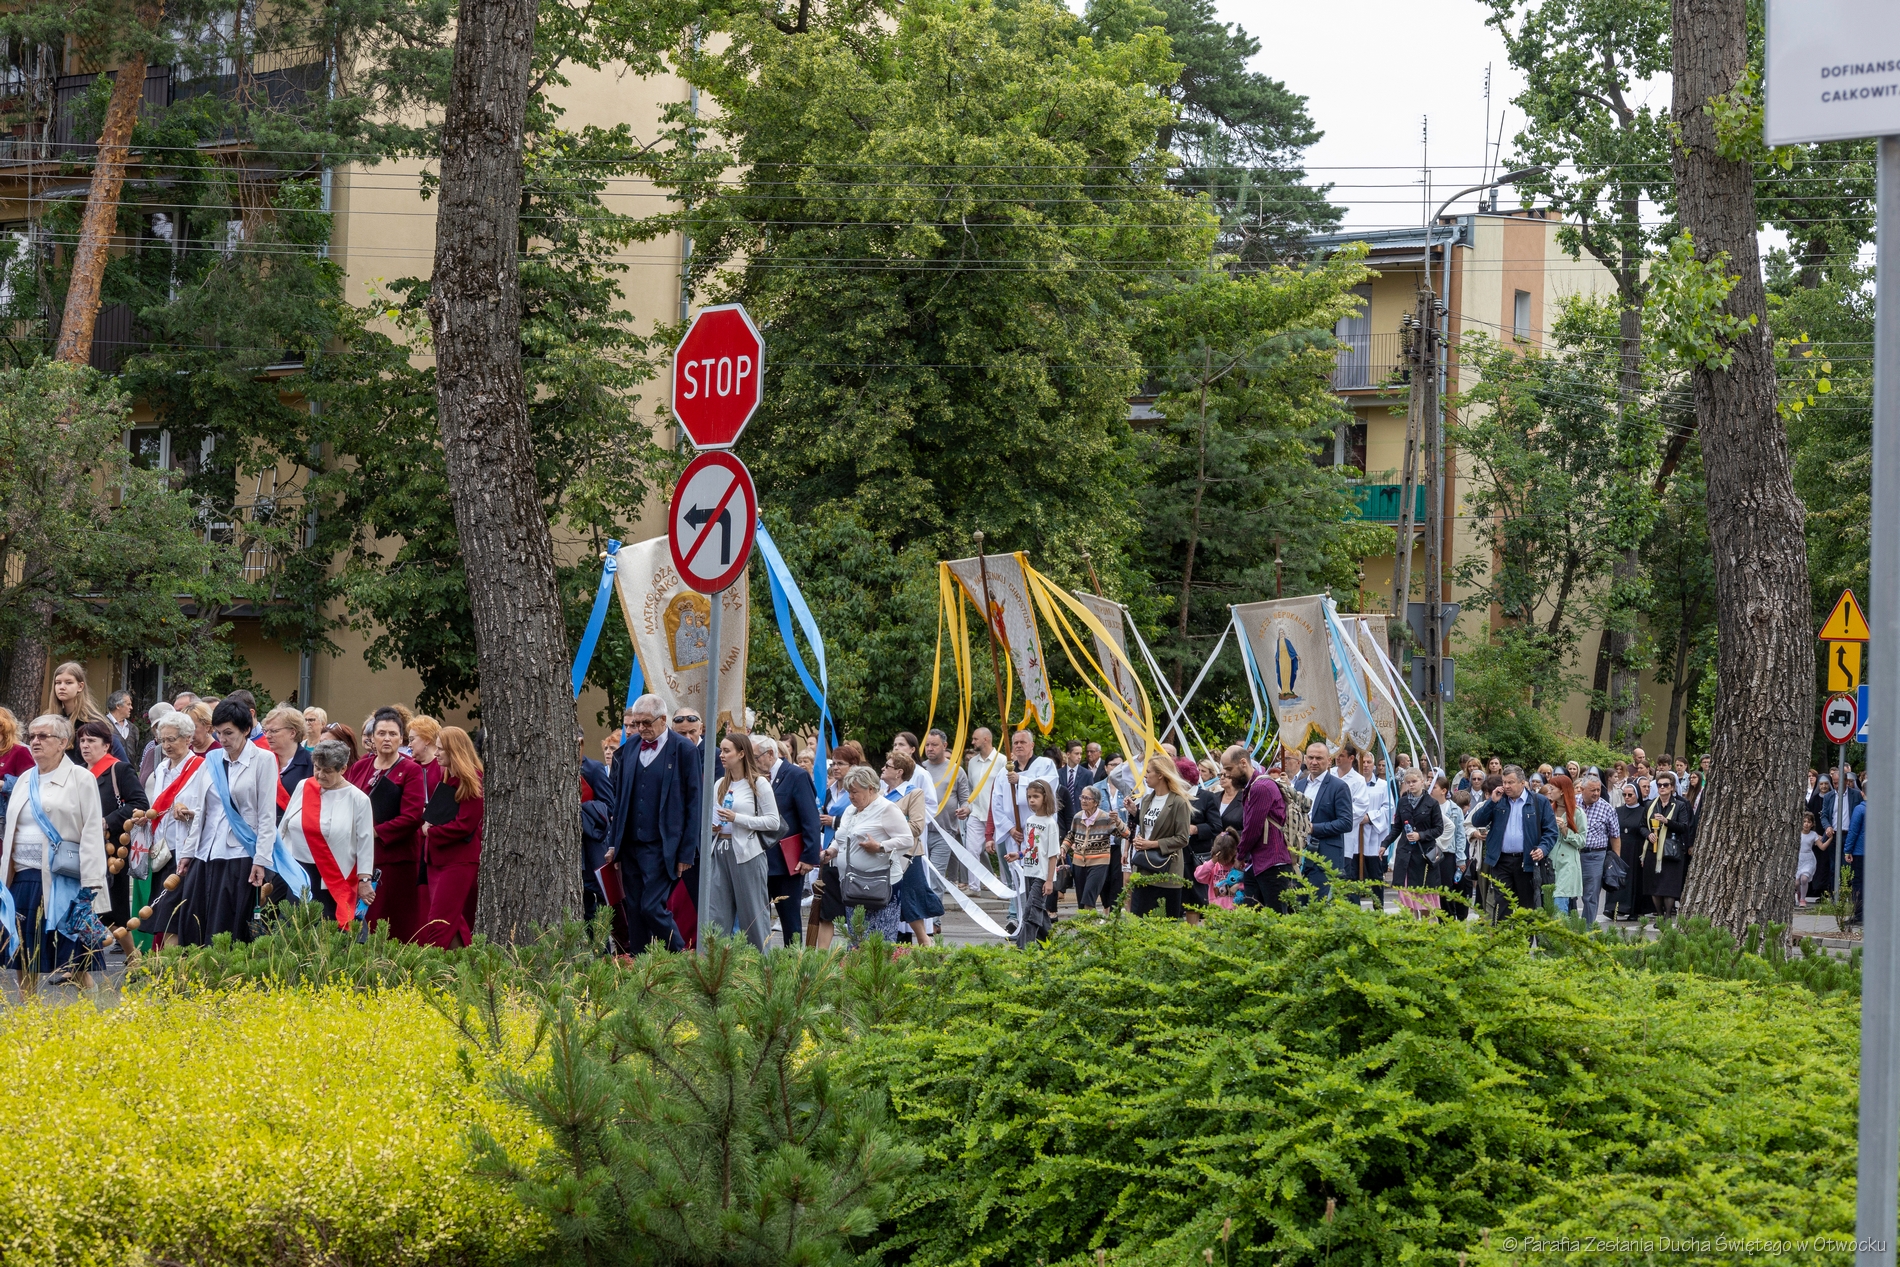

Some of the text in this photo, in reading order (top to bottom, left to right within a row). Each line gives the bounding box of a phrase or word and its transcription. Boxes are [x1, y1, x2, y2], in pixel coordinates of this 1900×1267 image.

[1821, 84, 1900, 103] CAŁKOWIT
[683, 355, 752, 399] STOP
[644, 593, 655, 635] MATKO
[1007, 582, 1032, 630] CHRYSTUSA
[687, 682, 701, 695] SIĘ
[719, 646, 740, 675] NAMI
[1282, 705, 1316, 723] JEZUSA
